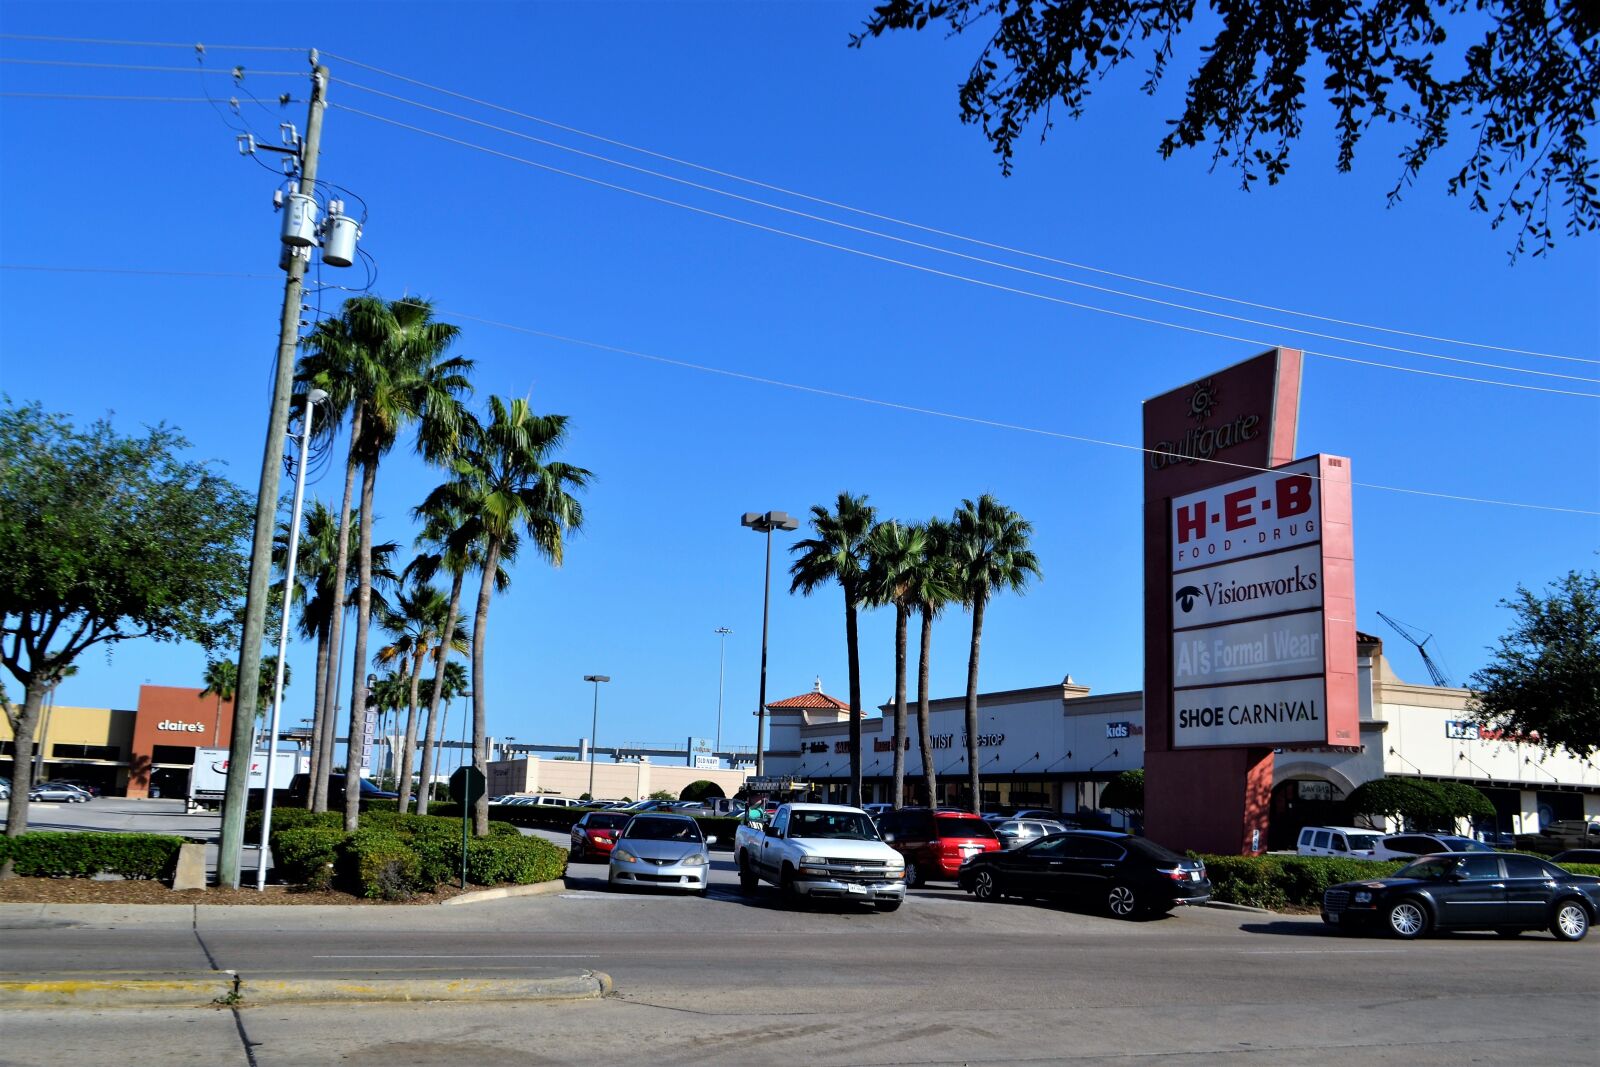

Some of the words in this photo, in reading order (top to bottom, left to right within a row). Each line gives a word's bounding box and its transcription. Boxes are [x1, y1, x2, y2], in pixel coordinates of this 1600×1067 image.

[1150, 414, 1260, 471] Gulfgate
[1178, 539, 1232, 562] FOOD
[1258, 520, 1314, 544] DRUG
[1202, 564, 1318, 607] Visionworks
[1214, 633, 1269, 667] Formal
[1273, 629, 1320, 660] Wear
[157, 719, 206, 732] claire's
[1179, 706, 1225, 729] SHOE
